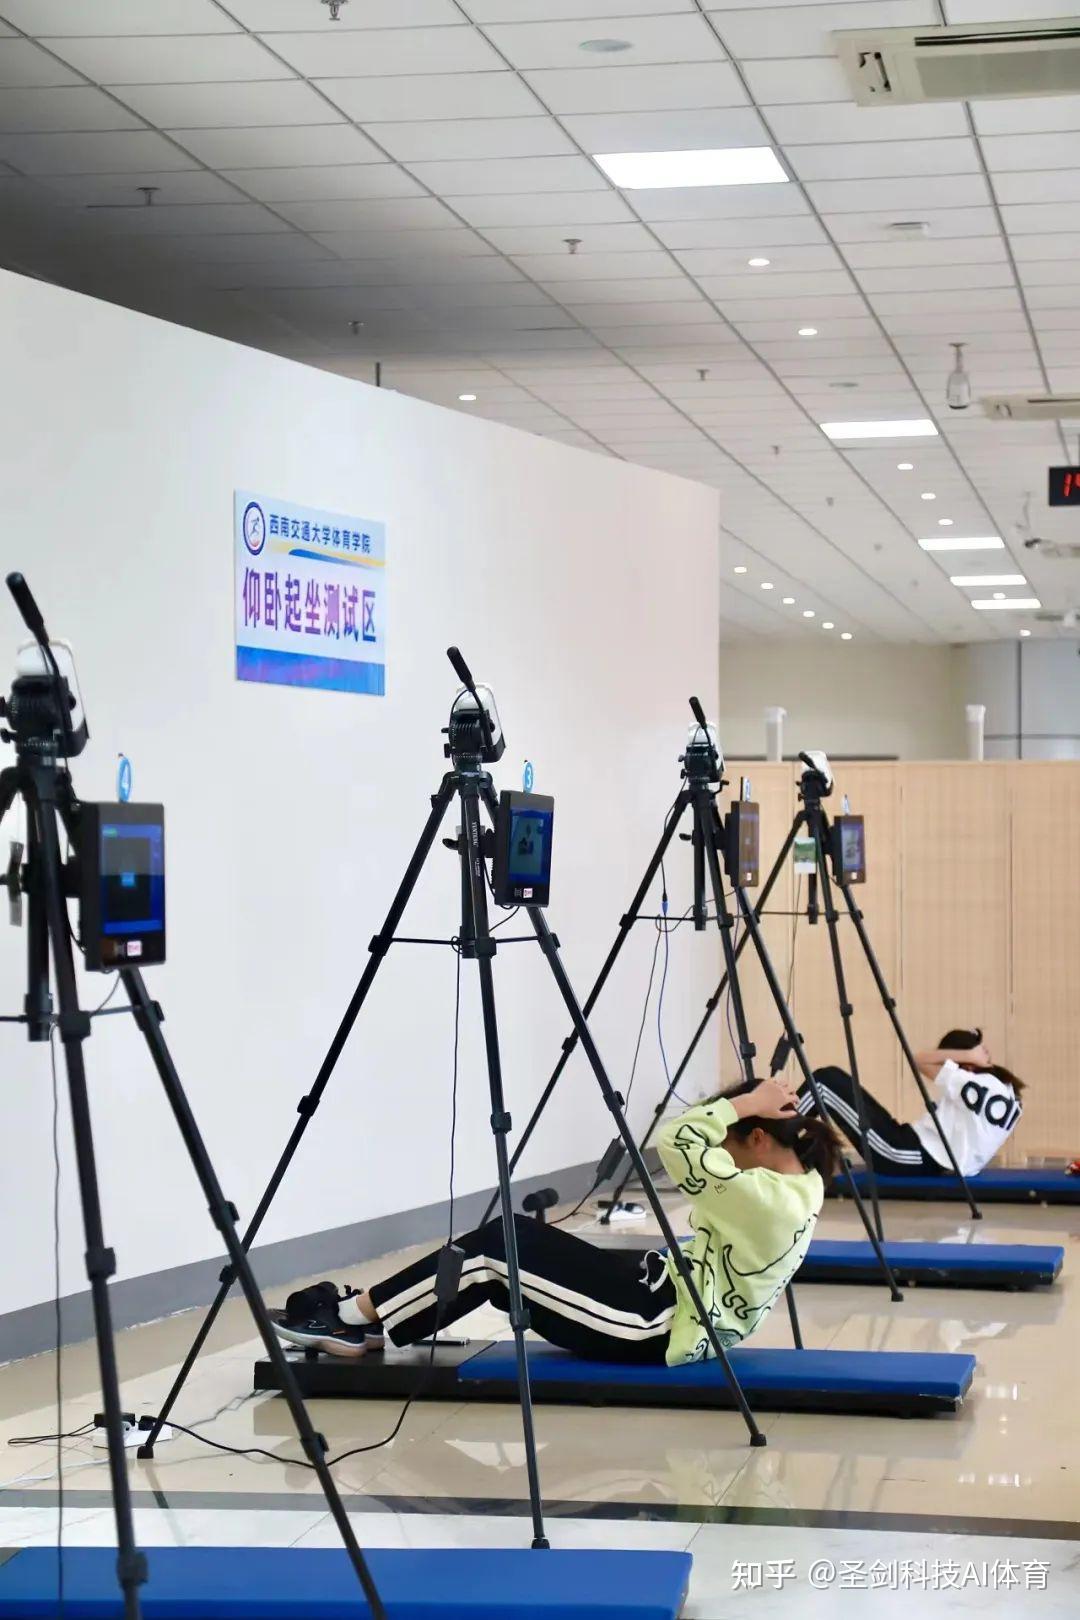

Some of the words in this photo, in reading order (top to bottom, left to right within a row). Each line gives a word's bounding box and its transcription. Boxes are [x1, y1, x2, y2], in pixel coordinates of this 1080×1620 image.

[269, 514, 371, 553] 西南交通大学体育学院
[243, 567, 376, 643] 仰卧起坐测试区
